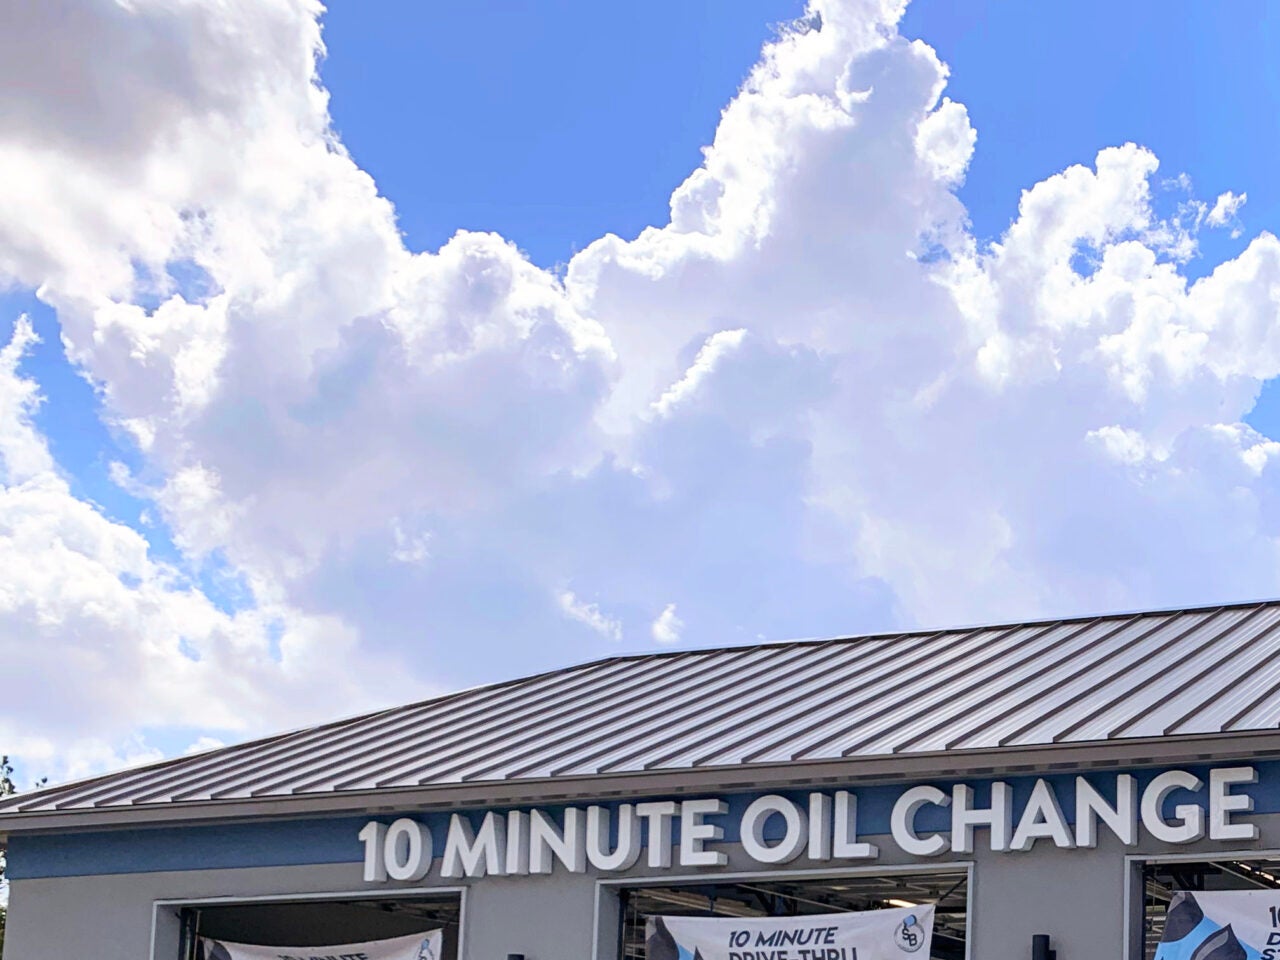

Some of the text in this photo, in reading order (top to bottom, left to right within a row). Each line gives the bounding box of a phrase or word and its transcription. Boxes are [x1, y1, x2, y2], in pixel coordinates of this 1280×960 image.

[358, 766, 1260, 882] 10 MINUTE OIL CHANGE
[728, 926, 838, 948] 10 MINUTE
